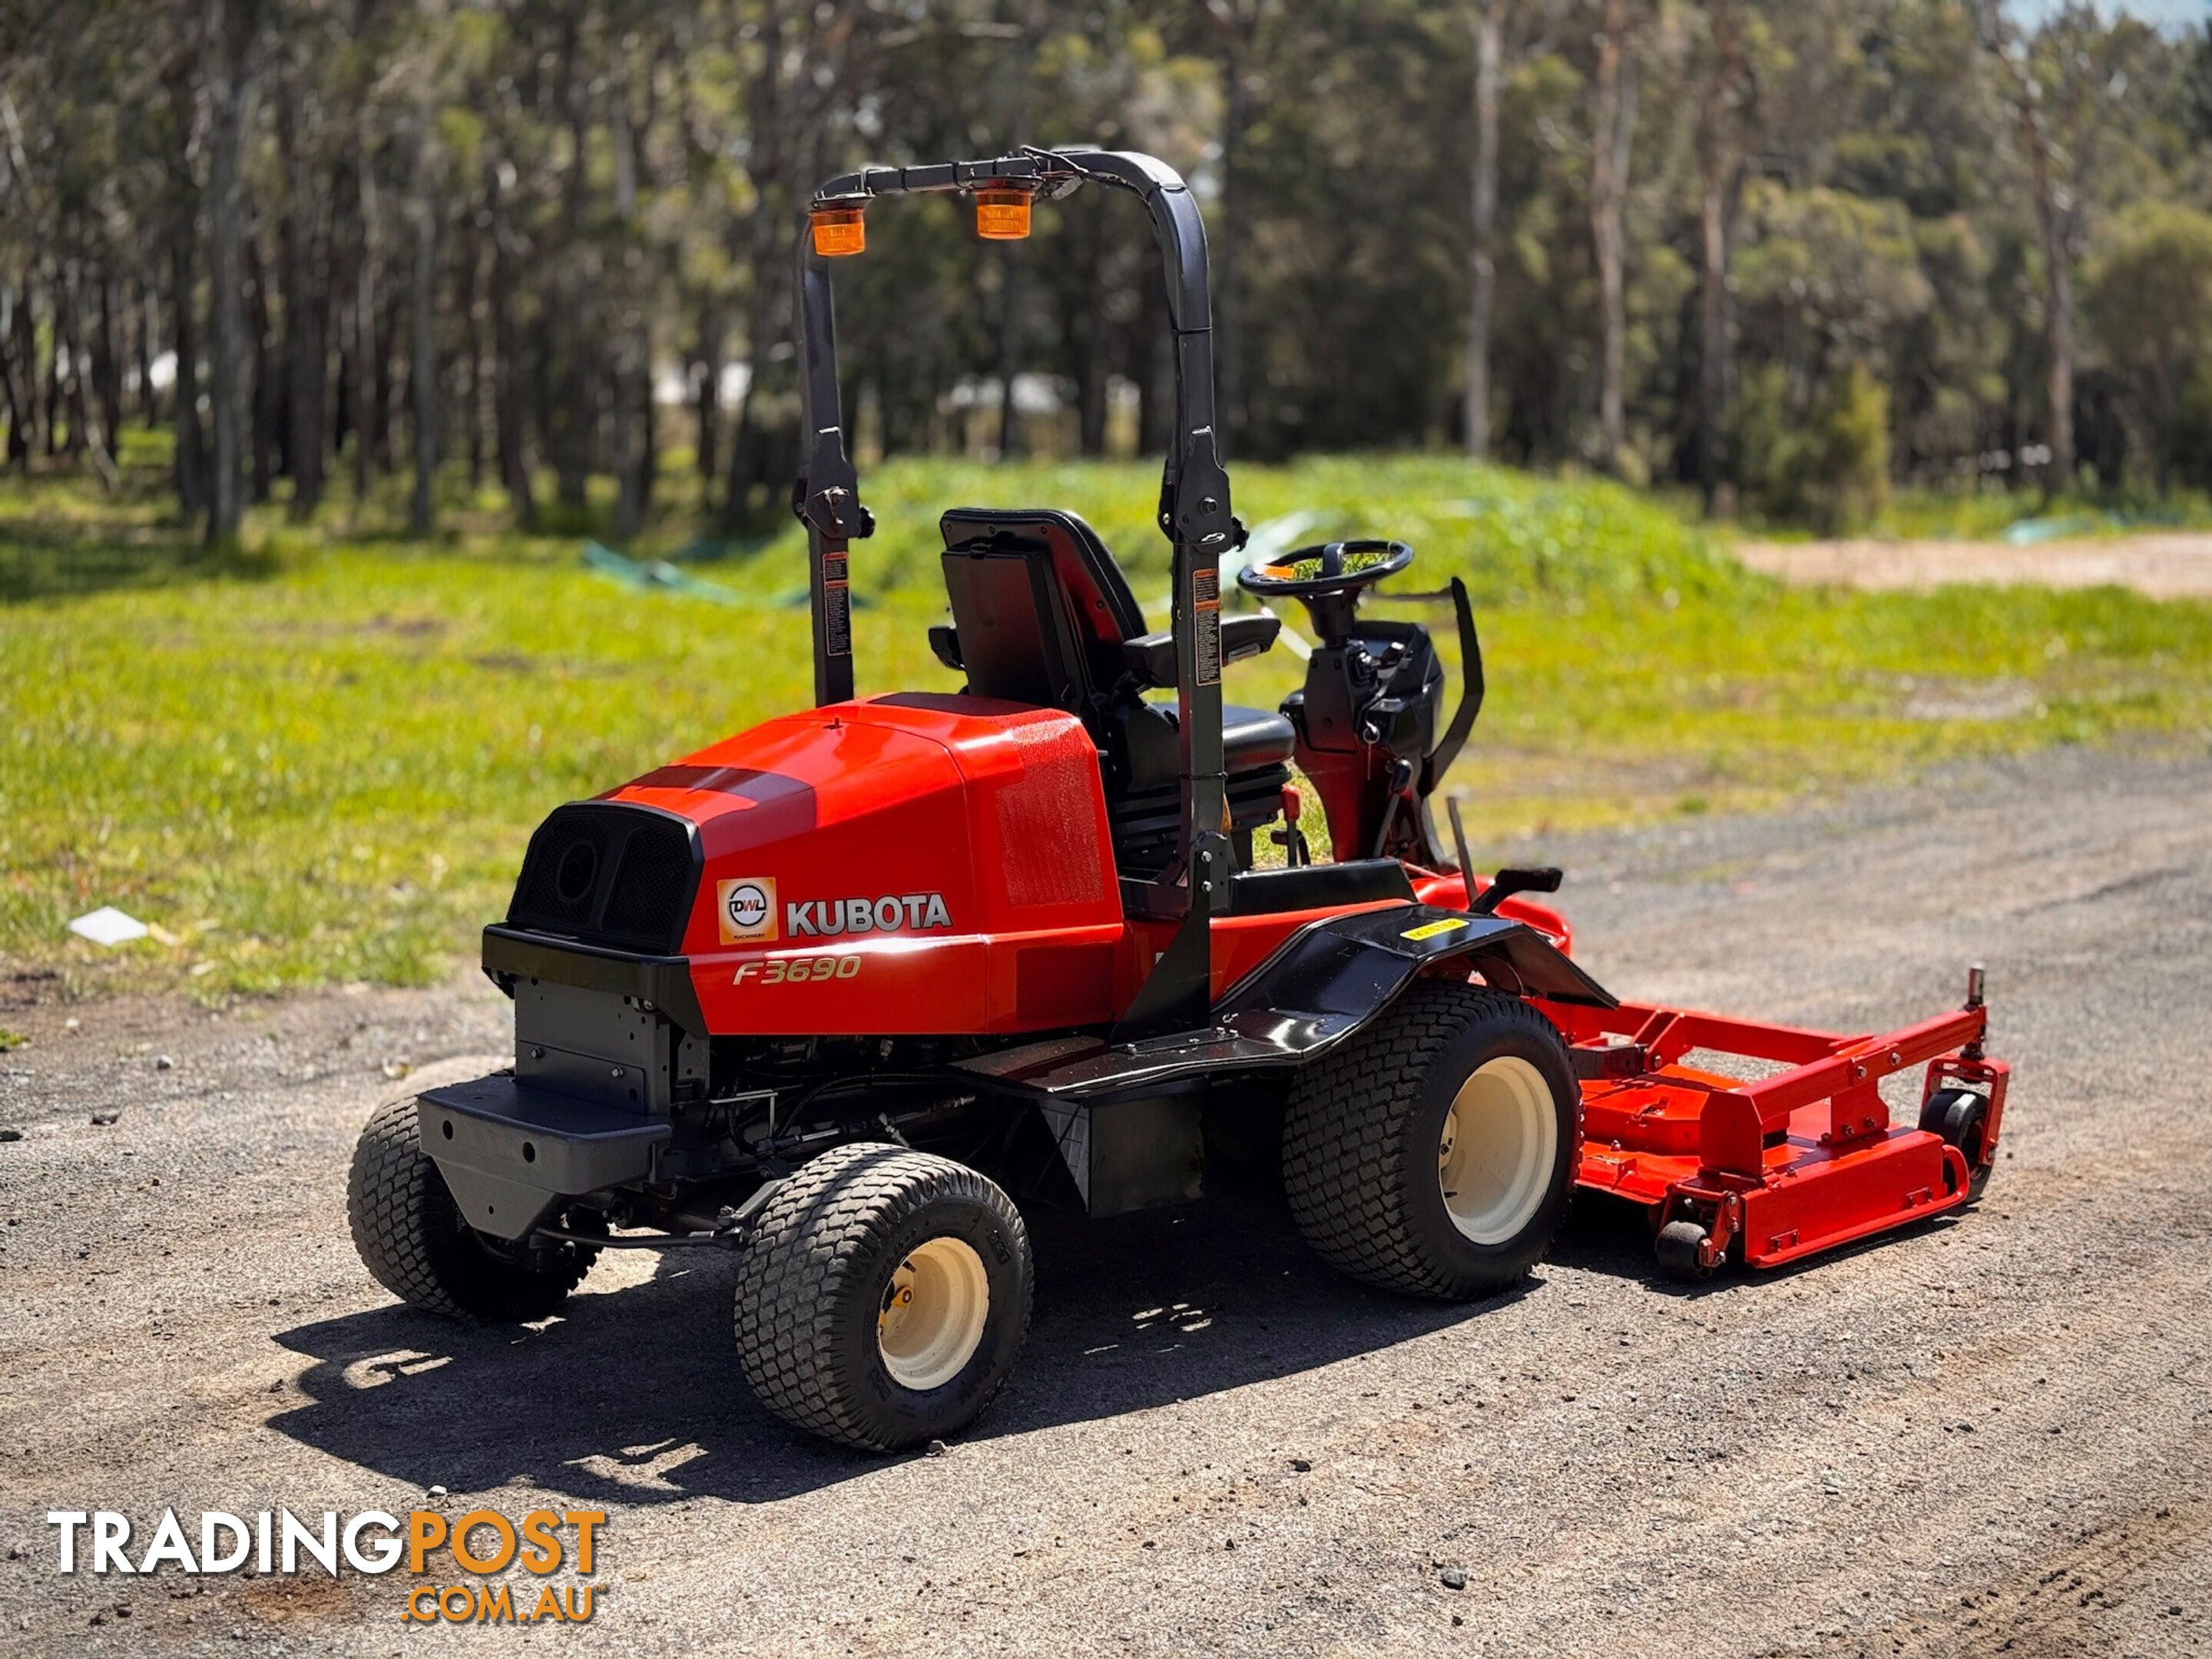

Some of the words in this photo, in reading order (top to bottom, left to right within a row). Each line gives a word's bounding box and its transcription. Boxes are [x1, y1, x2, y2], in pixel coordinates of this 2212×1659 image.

[729, 899, 767, 912] DWL
[786, 892, 953, 938] KUBOTA
[732, 955, 862, 985] F3690
